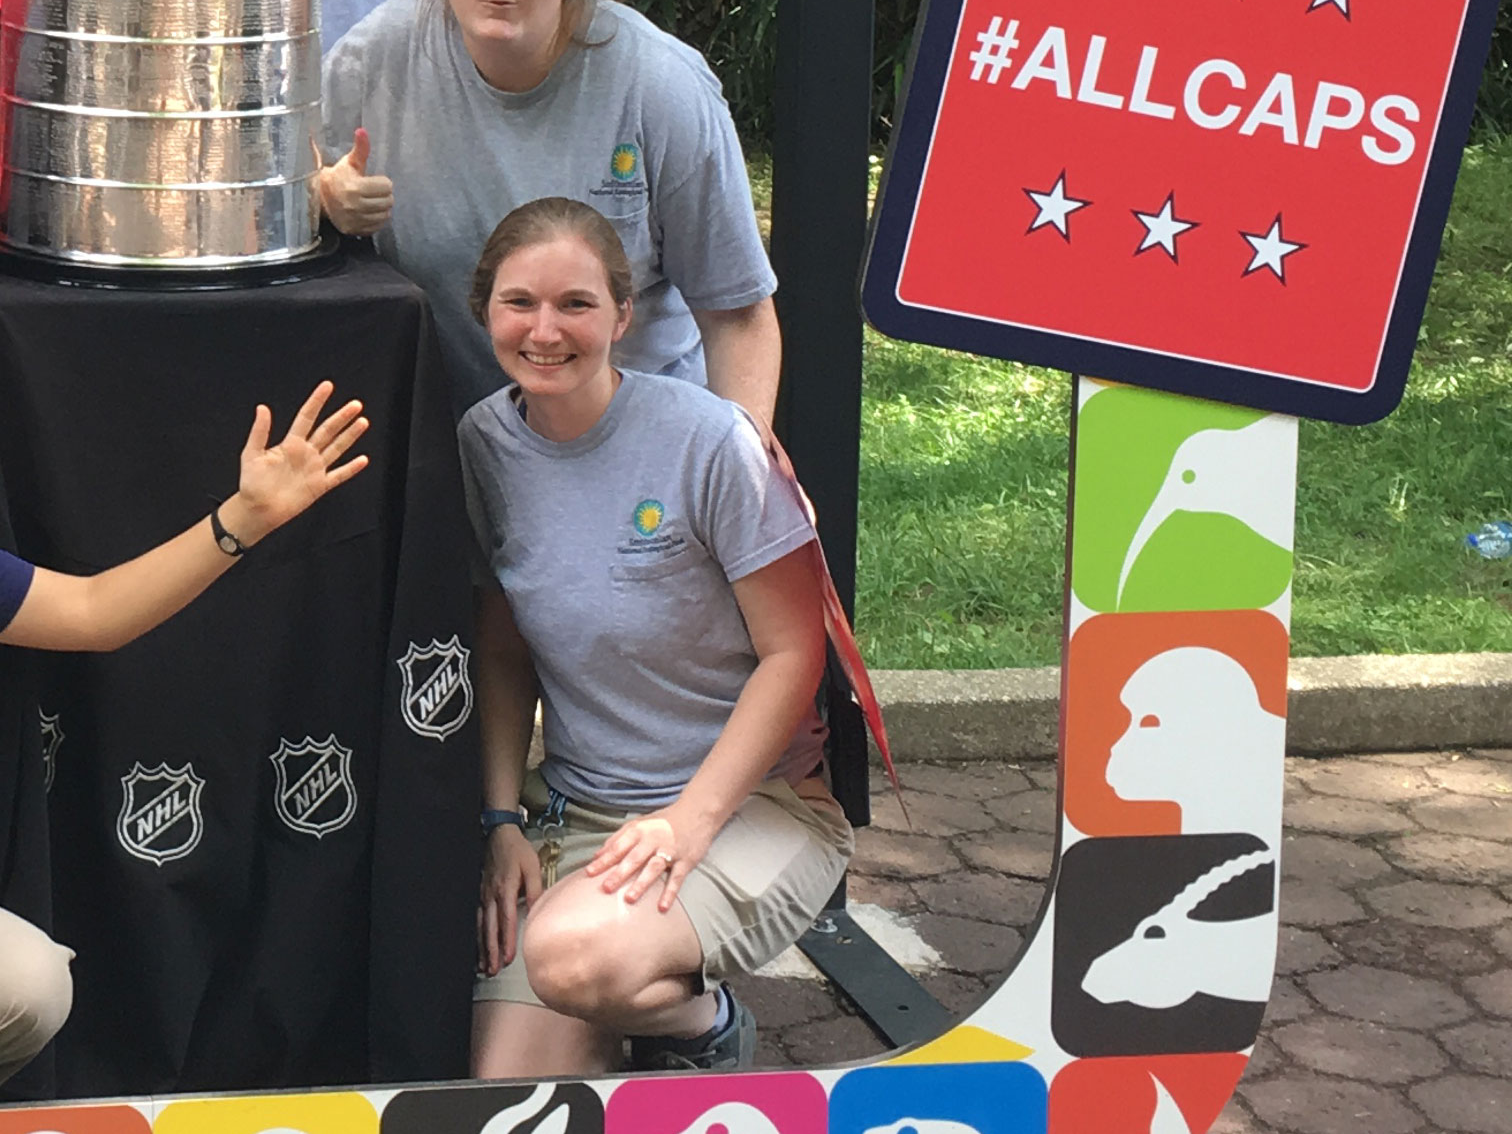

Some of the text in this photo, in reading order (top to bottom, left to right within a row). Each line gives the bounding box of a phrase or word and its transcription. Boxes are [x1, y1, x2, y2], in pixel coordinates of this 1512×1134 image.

[969, 16, 1420, 165] #ALLCAPS
[419, 663, 458, 721] NHL
[137, 790, 187, 842] NHL
[293, 761, 338, 816] NHL
